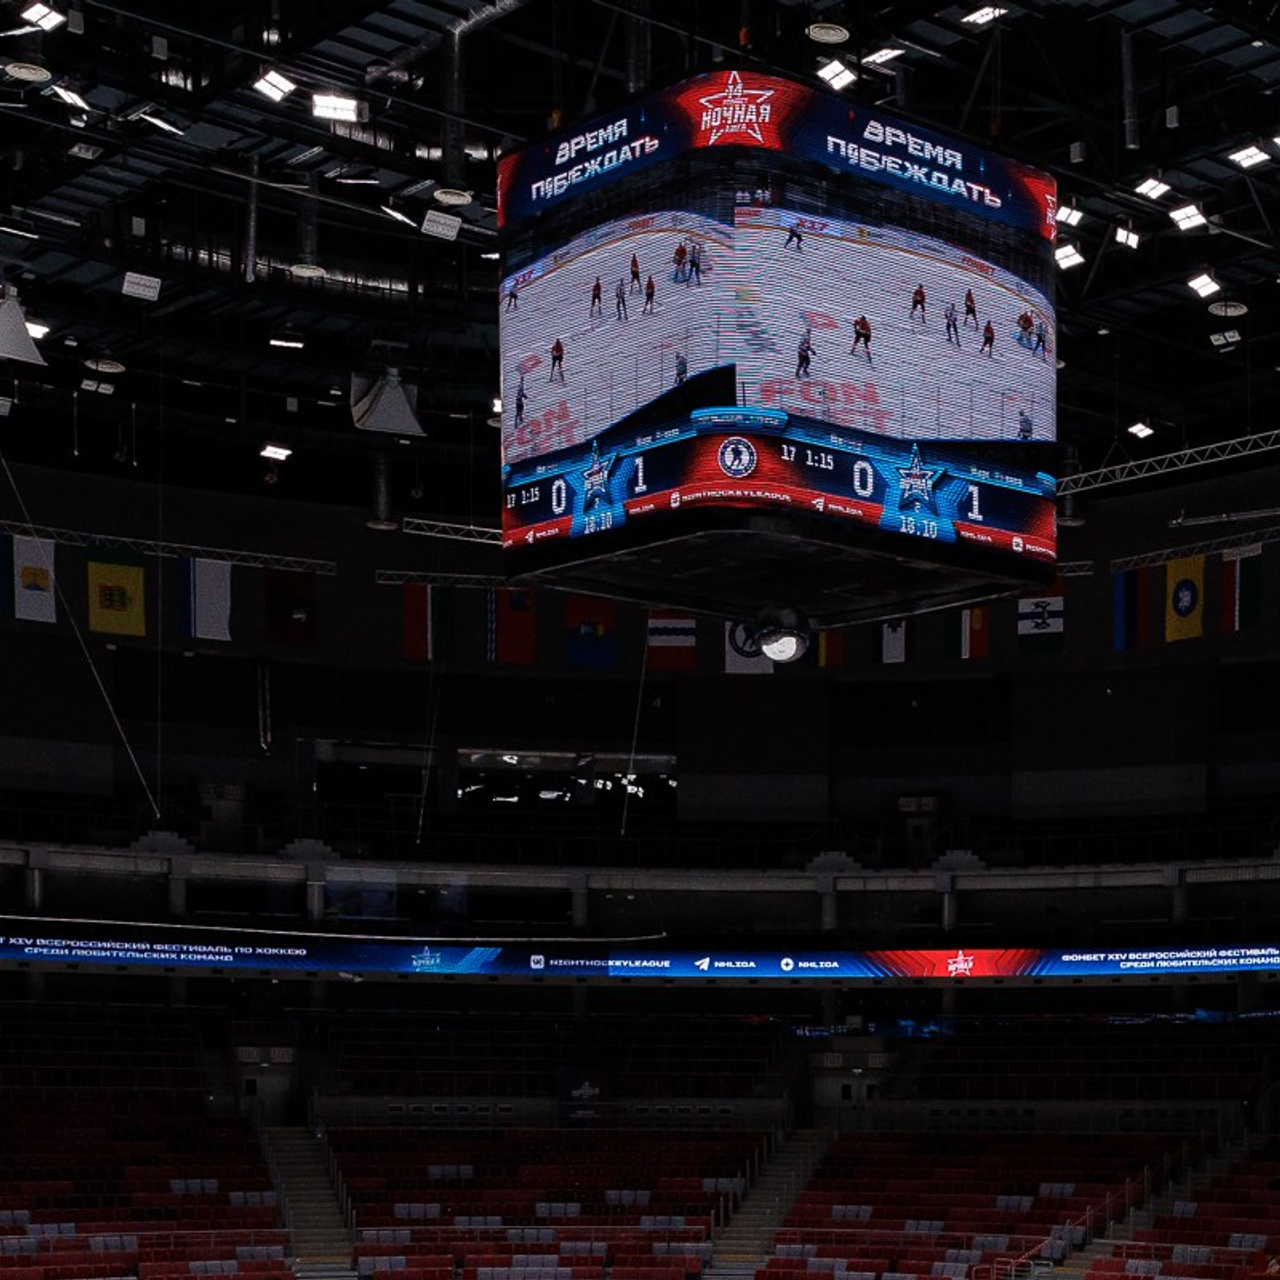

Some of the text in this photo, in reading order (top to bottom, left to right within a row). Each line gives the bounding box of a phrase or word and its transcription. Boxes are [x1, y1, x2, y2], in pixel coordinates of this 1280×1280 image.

[701, 103, 771, 131] НОЧНАЯ
[555, 119, 628, 166] ВРЕМЯ
[863, 120, 963, 172] ВРЕМЯ
[780, 445, 834, 471] 17 1:15
[634, 457, 648, 494] 1
[853, 460, 874, 498] 0
[552, 479, 567, 515] 0
[968, 485, 983, 522] 1
[9, 937, 307, 957] XIV ВСЕРОССИЙСКИЙ ФЕСТИВАЛЬ ПО ХОККЕЮ
[24, 946, 234, 962] СРЕДИ ЛЮБИТЕЛЬСКИХ КОМАНД
[1062, 953, 1106, 962] ФОНБЕТ
[1107, 952, 1127, 961] XIV
[1128, 948, 1217, 961] ВСЕРОССИЙСКИЙ
[1219, 947, 1280, 959] ФЕСТИВАЛЬ
[1120, 956, 1280, 969] СРЕДИ ЛЮБИТЕЛЬСКИХ КОМАНД
